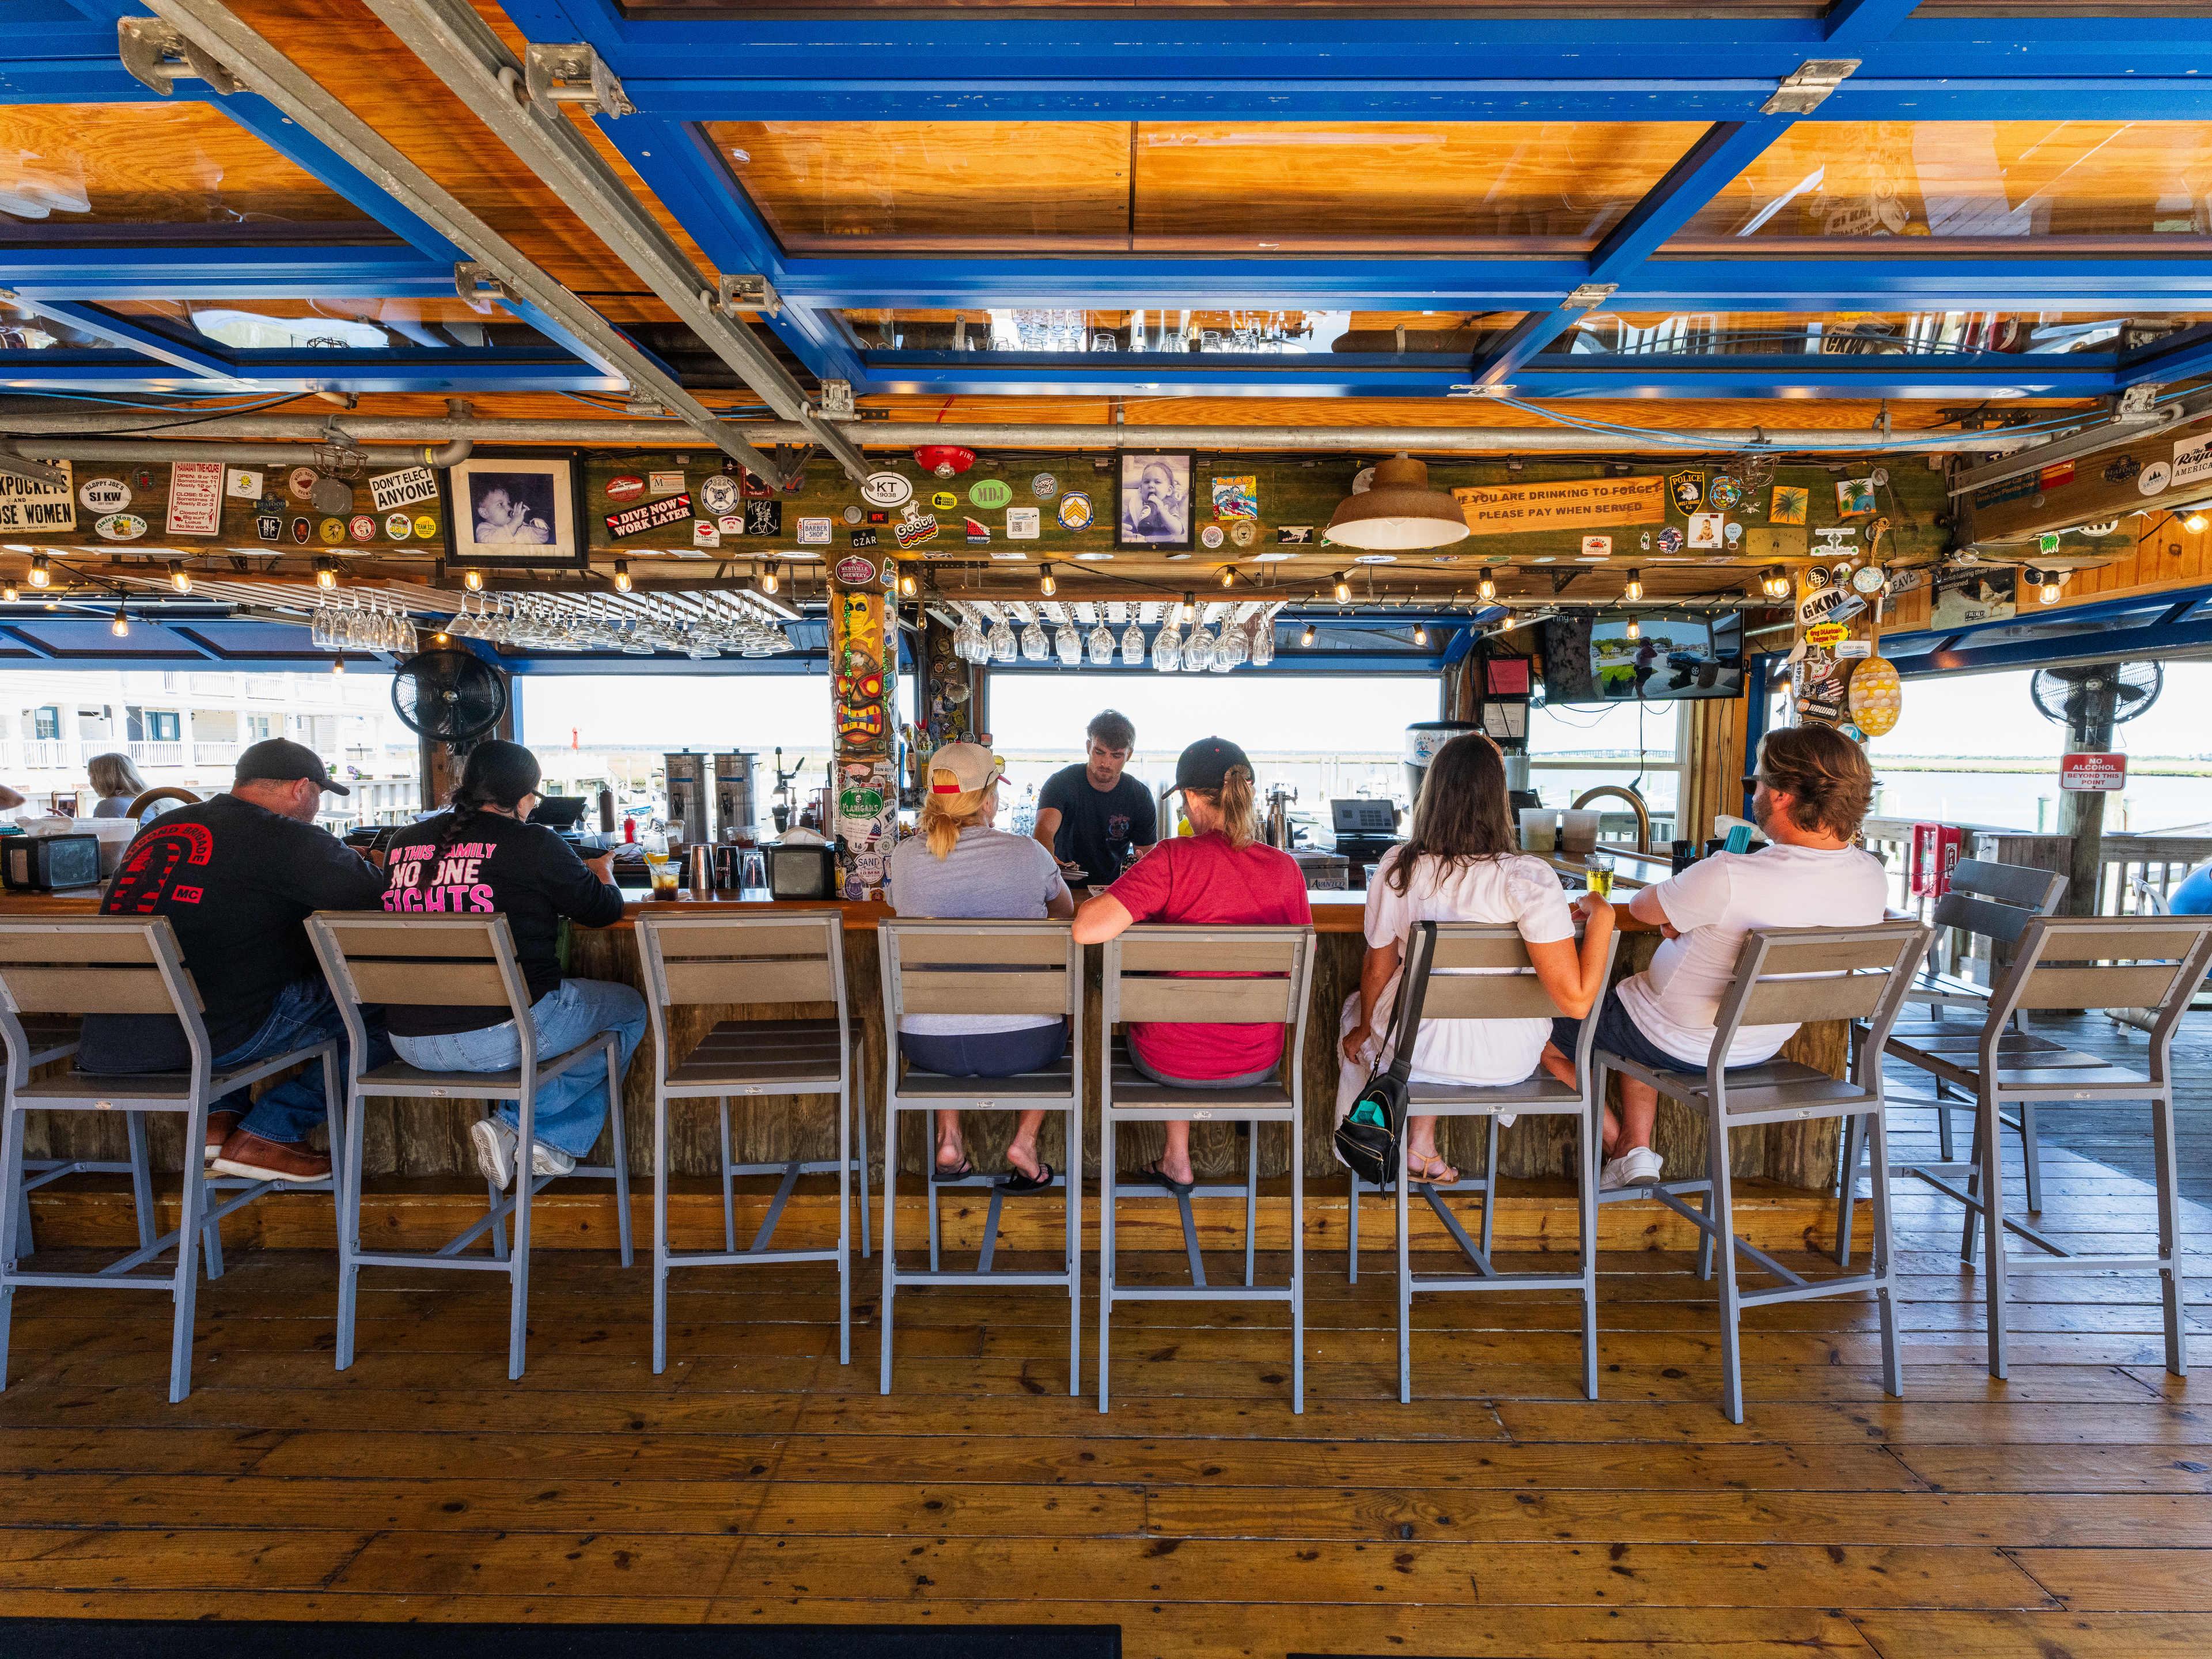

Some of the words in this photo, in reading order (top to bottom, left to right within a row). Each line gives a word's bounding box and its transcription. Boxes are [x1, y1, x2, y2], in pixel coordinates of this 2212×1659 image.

[959, 450, 974, 461] FIRE
[196, 463, 206, 472] TIME
[206, 464, 219, 472] HOURS
[85, 480, 107, 491] SLOPPY
[108, 481, 124, 491] JOE'S
[372, 475, 402, 491] DON'T
[403, 468, 430, 484] ELECT
[1035, 476, 1054, 487] Loose
[1217, 476, 1253, 486] DEAD
[1672, 474, 1702, 485] POLICE
[1994, 480, 2011, 489] Never
[2142, 474, 2168, 489] SKYWAY
[378, 479, 436, 508] ANYONE
[877, 482, 897, 493] KT
[1035, 484, 1054, 496] Ends
[2002, 486, 2021, 495] Pants
[89, 492, 101, 502] SJ
[104, 492, 122, 502] KW
[977, 486, 1004, 502] MDJ
[1458, 495, 1468, 505] IF
[1471, 493, 1497, 504] YOU
[1502, 491, 1525, 502] ARE
[1529, 488, 1589, 500] DRINKING
[1593, 487, 1609, 497] TO
[1613, 484, 1661, 495] FORGET
[24, 503, 72, 524] WOMEN
[619, 507, 649, 524] DIVE
[649, 498, 677, 515] NOW
[1479, 509, 1524, 520] PLEASE
[1528, 507, 1552, 517] PAY
[1555, 505, 1591, 516] WHEN
[1595, 502, 1642, 514] SERVED
[97, 517, 114, 529] Quiet
[133, 517, 146, 528] Pub
[263, 519, 276, 528] NC
[614, 518, 652, 537] WORK
[651, 507, 691, 526] LATER
[896, 515, 934, 536] Goats
[389, 525, 408, 534] 420
[853, 536, 877, 547] CZAR
[1586, 537, 1608, 547] SUNBURN
[1938, 579, 1969, 592] questioned
[1802, 590, 1843, 619] GKM
[1809, 704, 1838, 717] HAWAII
[181, 826, 208, 863] BRIGADE
[389, 847, 403, 865] IN
[403, 844, 435, 862] THIS
[444, 843, 497, 859] AMILY
[389, 861, 422, 889] NO
[1311, 879, 1345, 891] AVANTCO
[176, 888, 200, 900] MC
[381, 884, 494, 912] FIGHTS
